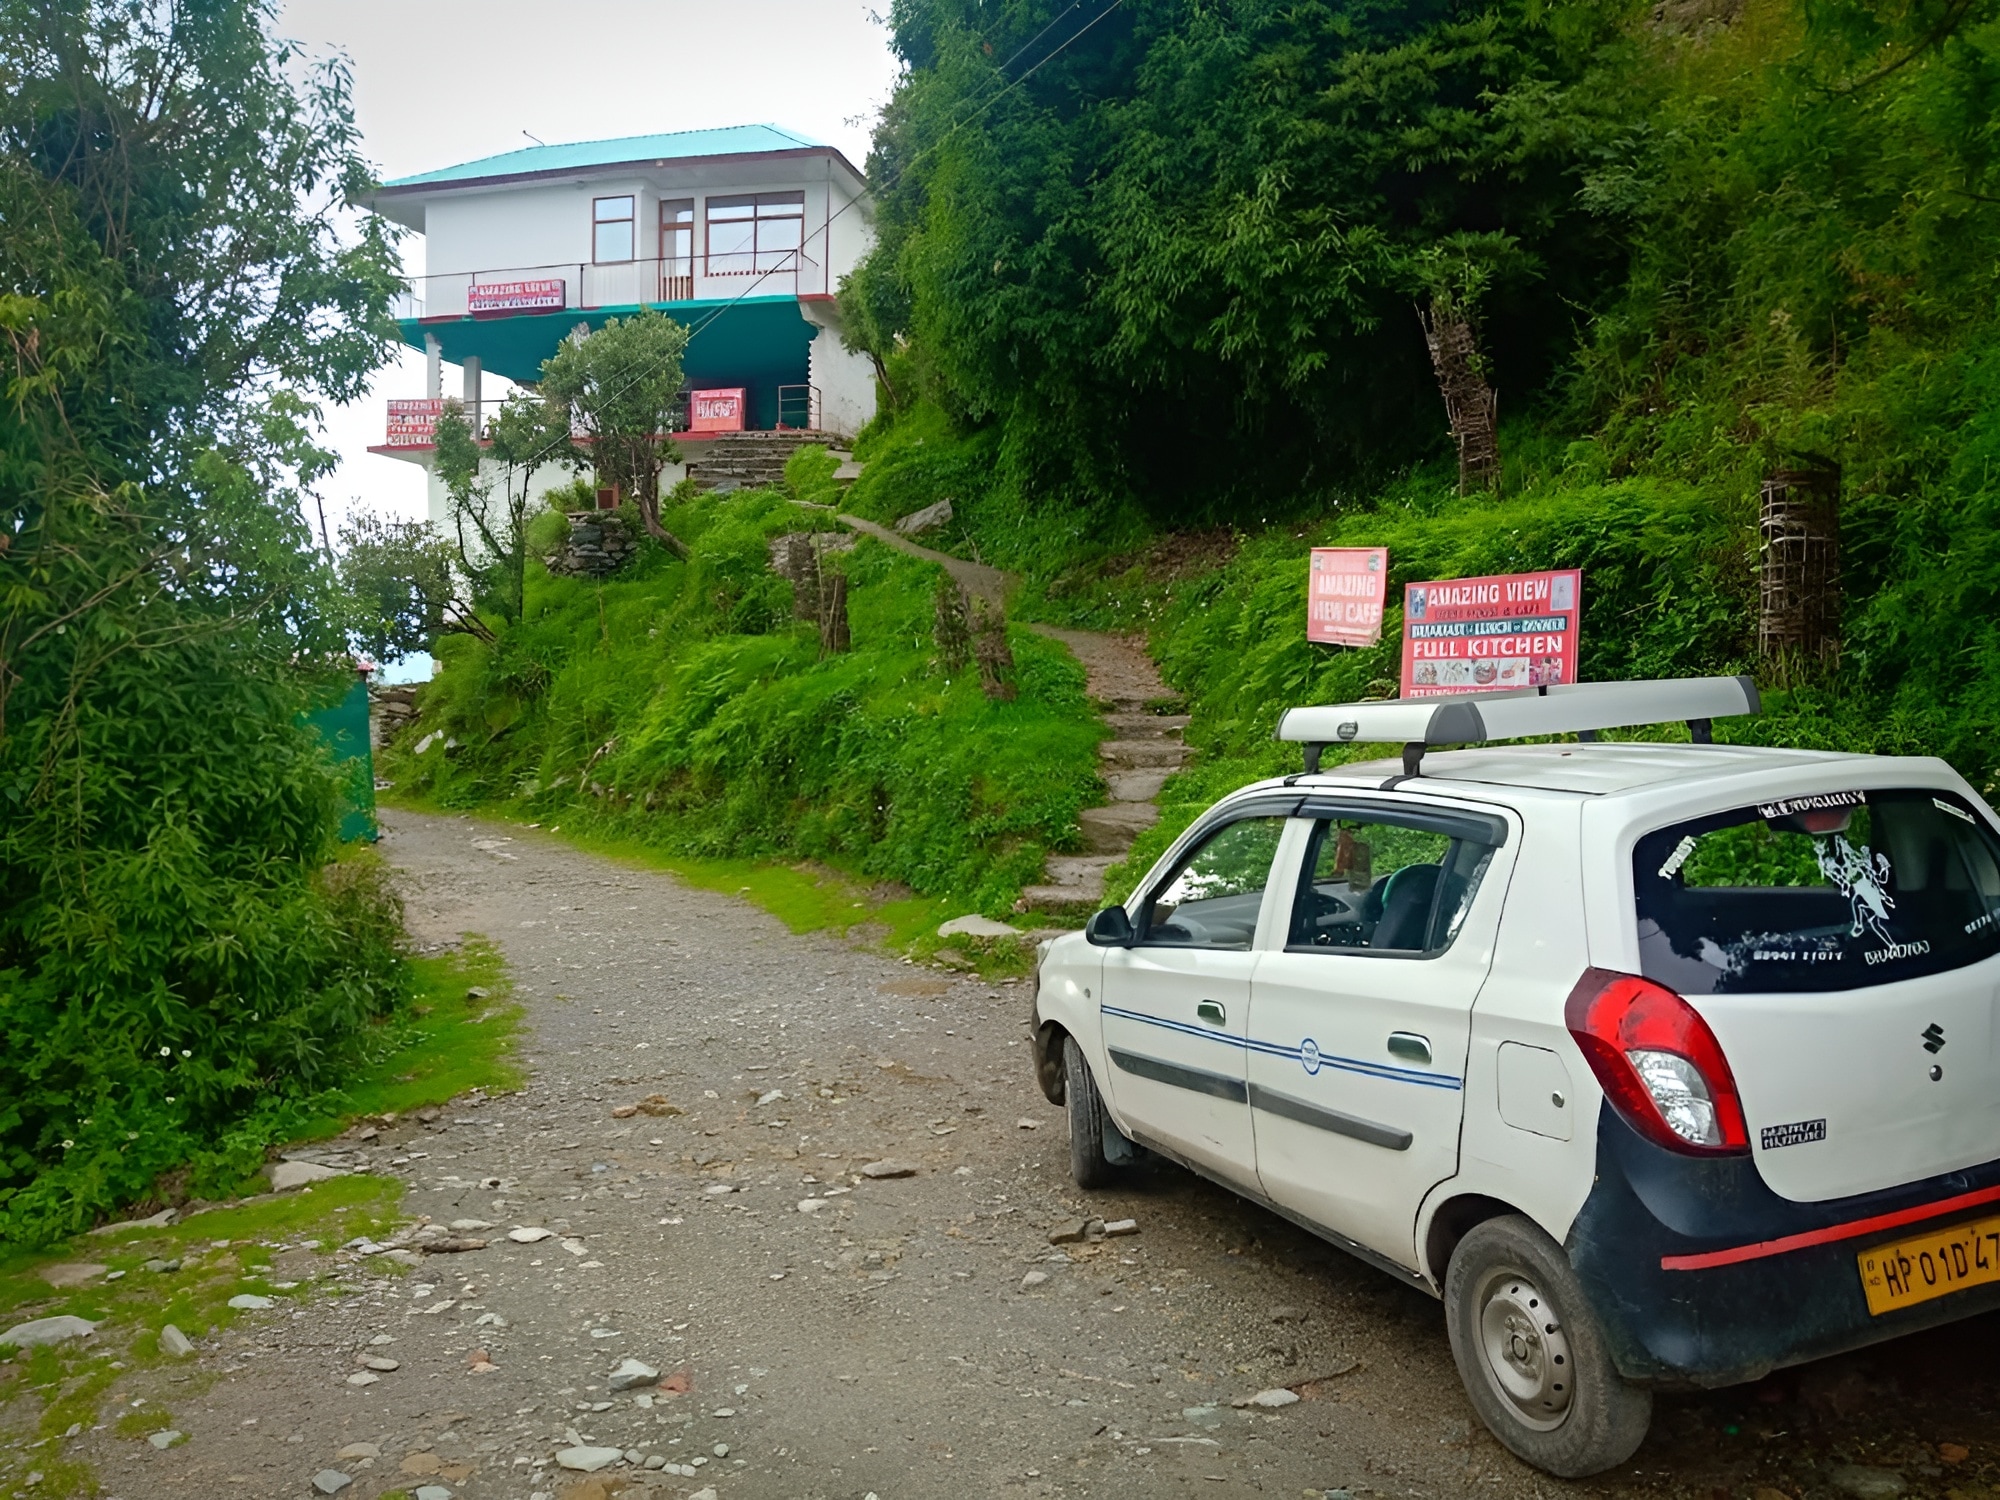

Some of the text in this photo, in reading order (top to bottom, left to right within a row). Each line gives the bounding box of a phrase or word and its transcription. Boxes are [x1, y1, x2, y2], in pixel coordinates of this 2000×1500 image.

[1428, 577, 1549, 607] AMAZING VIEW
[1413, 635, 1563, 658] FULL KITCHEN
